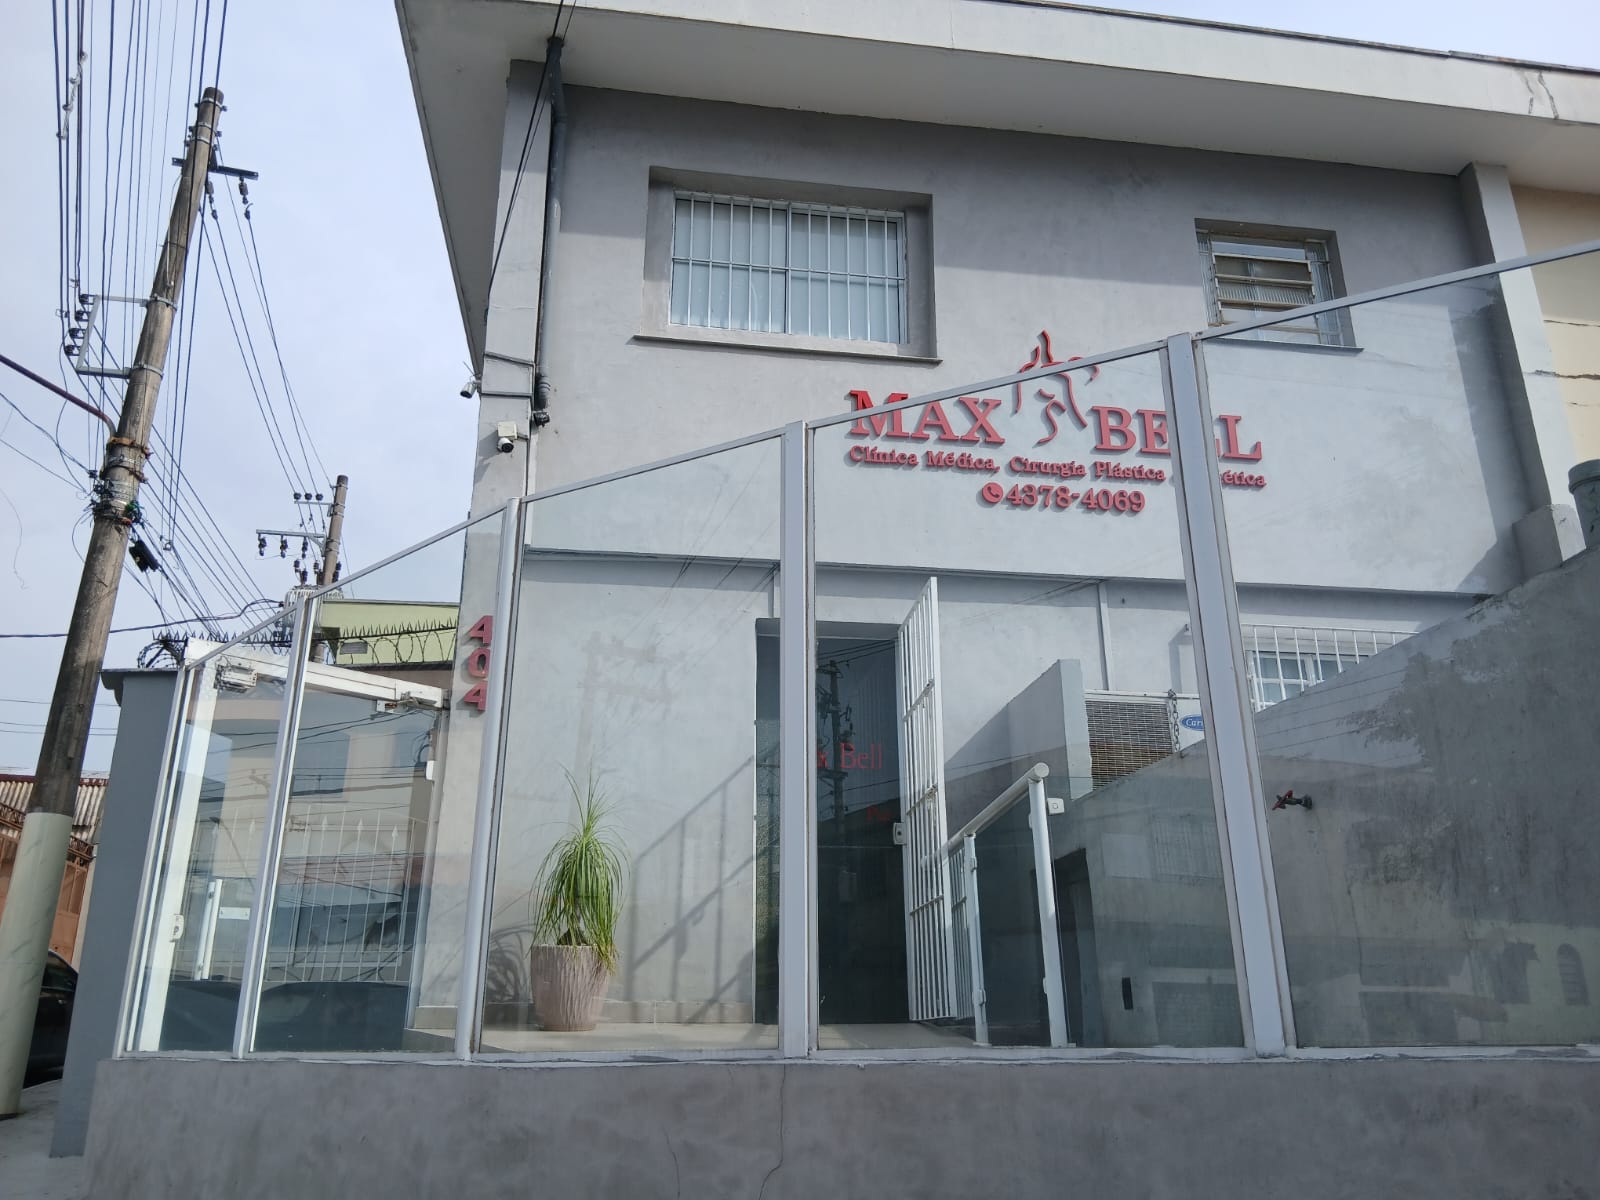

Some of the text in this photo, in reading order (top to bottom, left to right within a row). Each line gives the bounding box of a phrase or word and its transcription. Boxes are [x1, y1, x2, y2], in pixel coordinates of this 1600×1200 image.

[849, 389, 1263, 462] MAX BEL
[850, 445, 919, 466] Clínica
[925, 450, 1001, 474] Médica,
[1009, 456, 1087, 478] Cirurgia
[1094, 461, 1167, 482] Plástica
[1007, 484, 1146, 513] 4378-4069
[463, 615, 494, 713] 404
[839, 742, 884, 770] Bell
